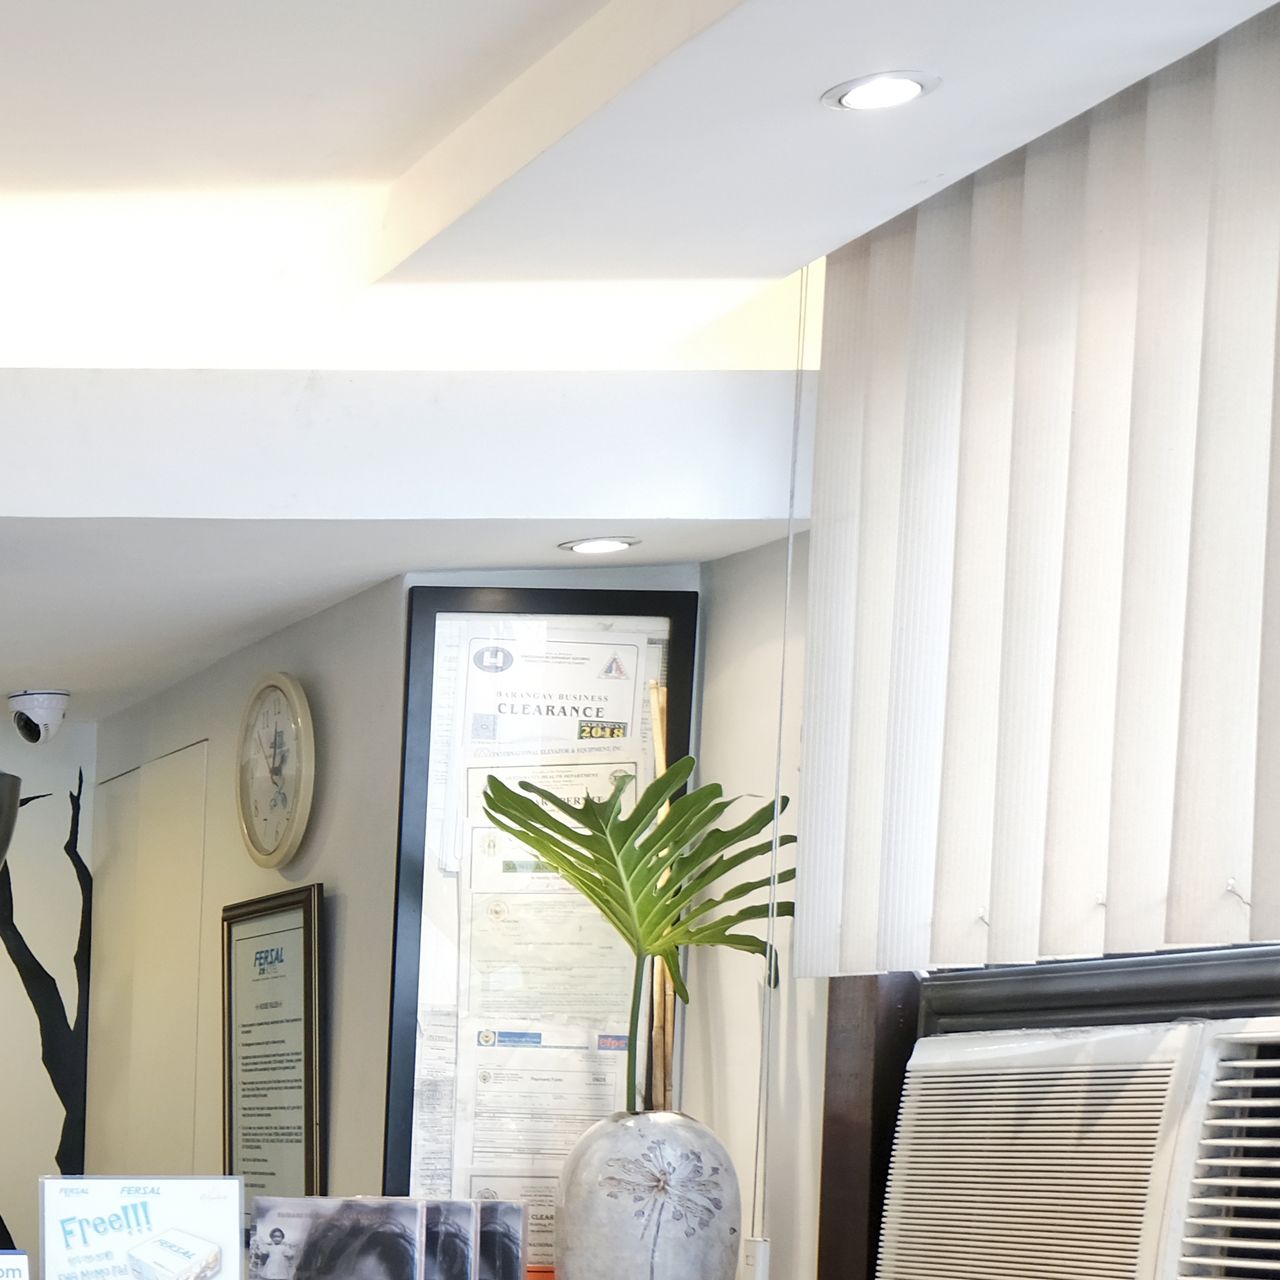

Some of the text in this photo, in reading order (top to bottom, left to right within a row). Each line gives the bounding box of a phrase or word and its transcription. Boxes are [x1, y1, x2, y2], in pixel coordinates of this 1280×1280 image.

[497, 703, 605, 718] CLEARANCE
[580, 726, 625, 739] 2018
[254, 947, 284, 967] FERSAL
[120, 1186, 161, 1195] FERSAL
[59, 1200, 153, 1249] Free!!!
[154, 1238, 196, 1259] FERSAL
